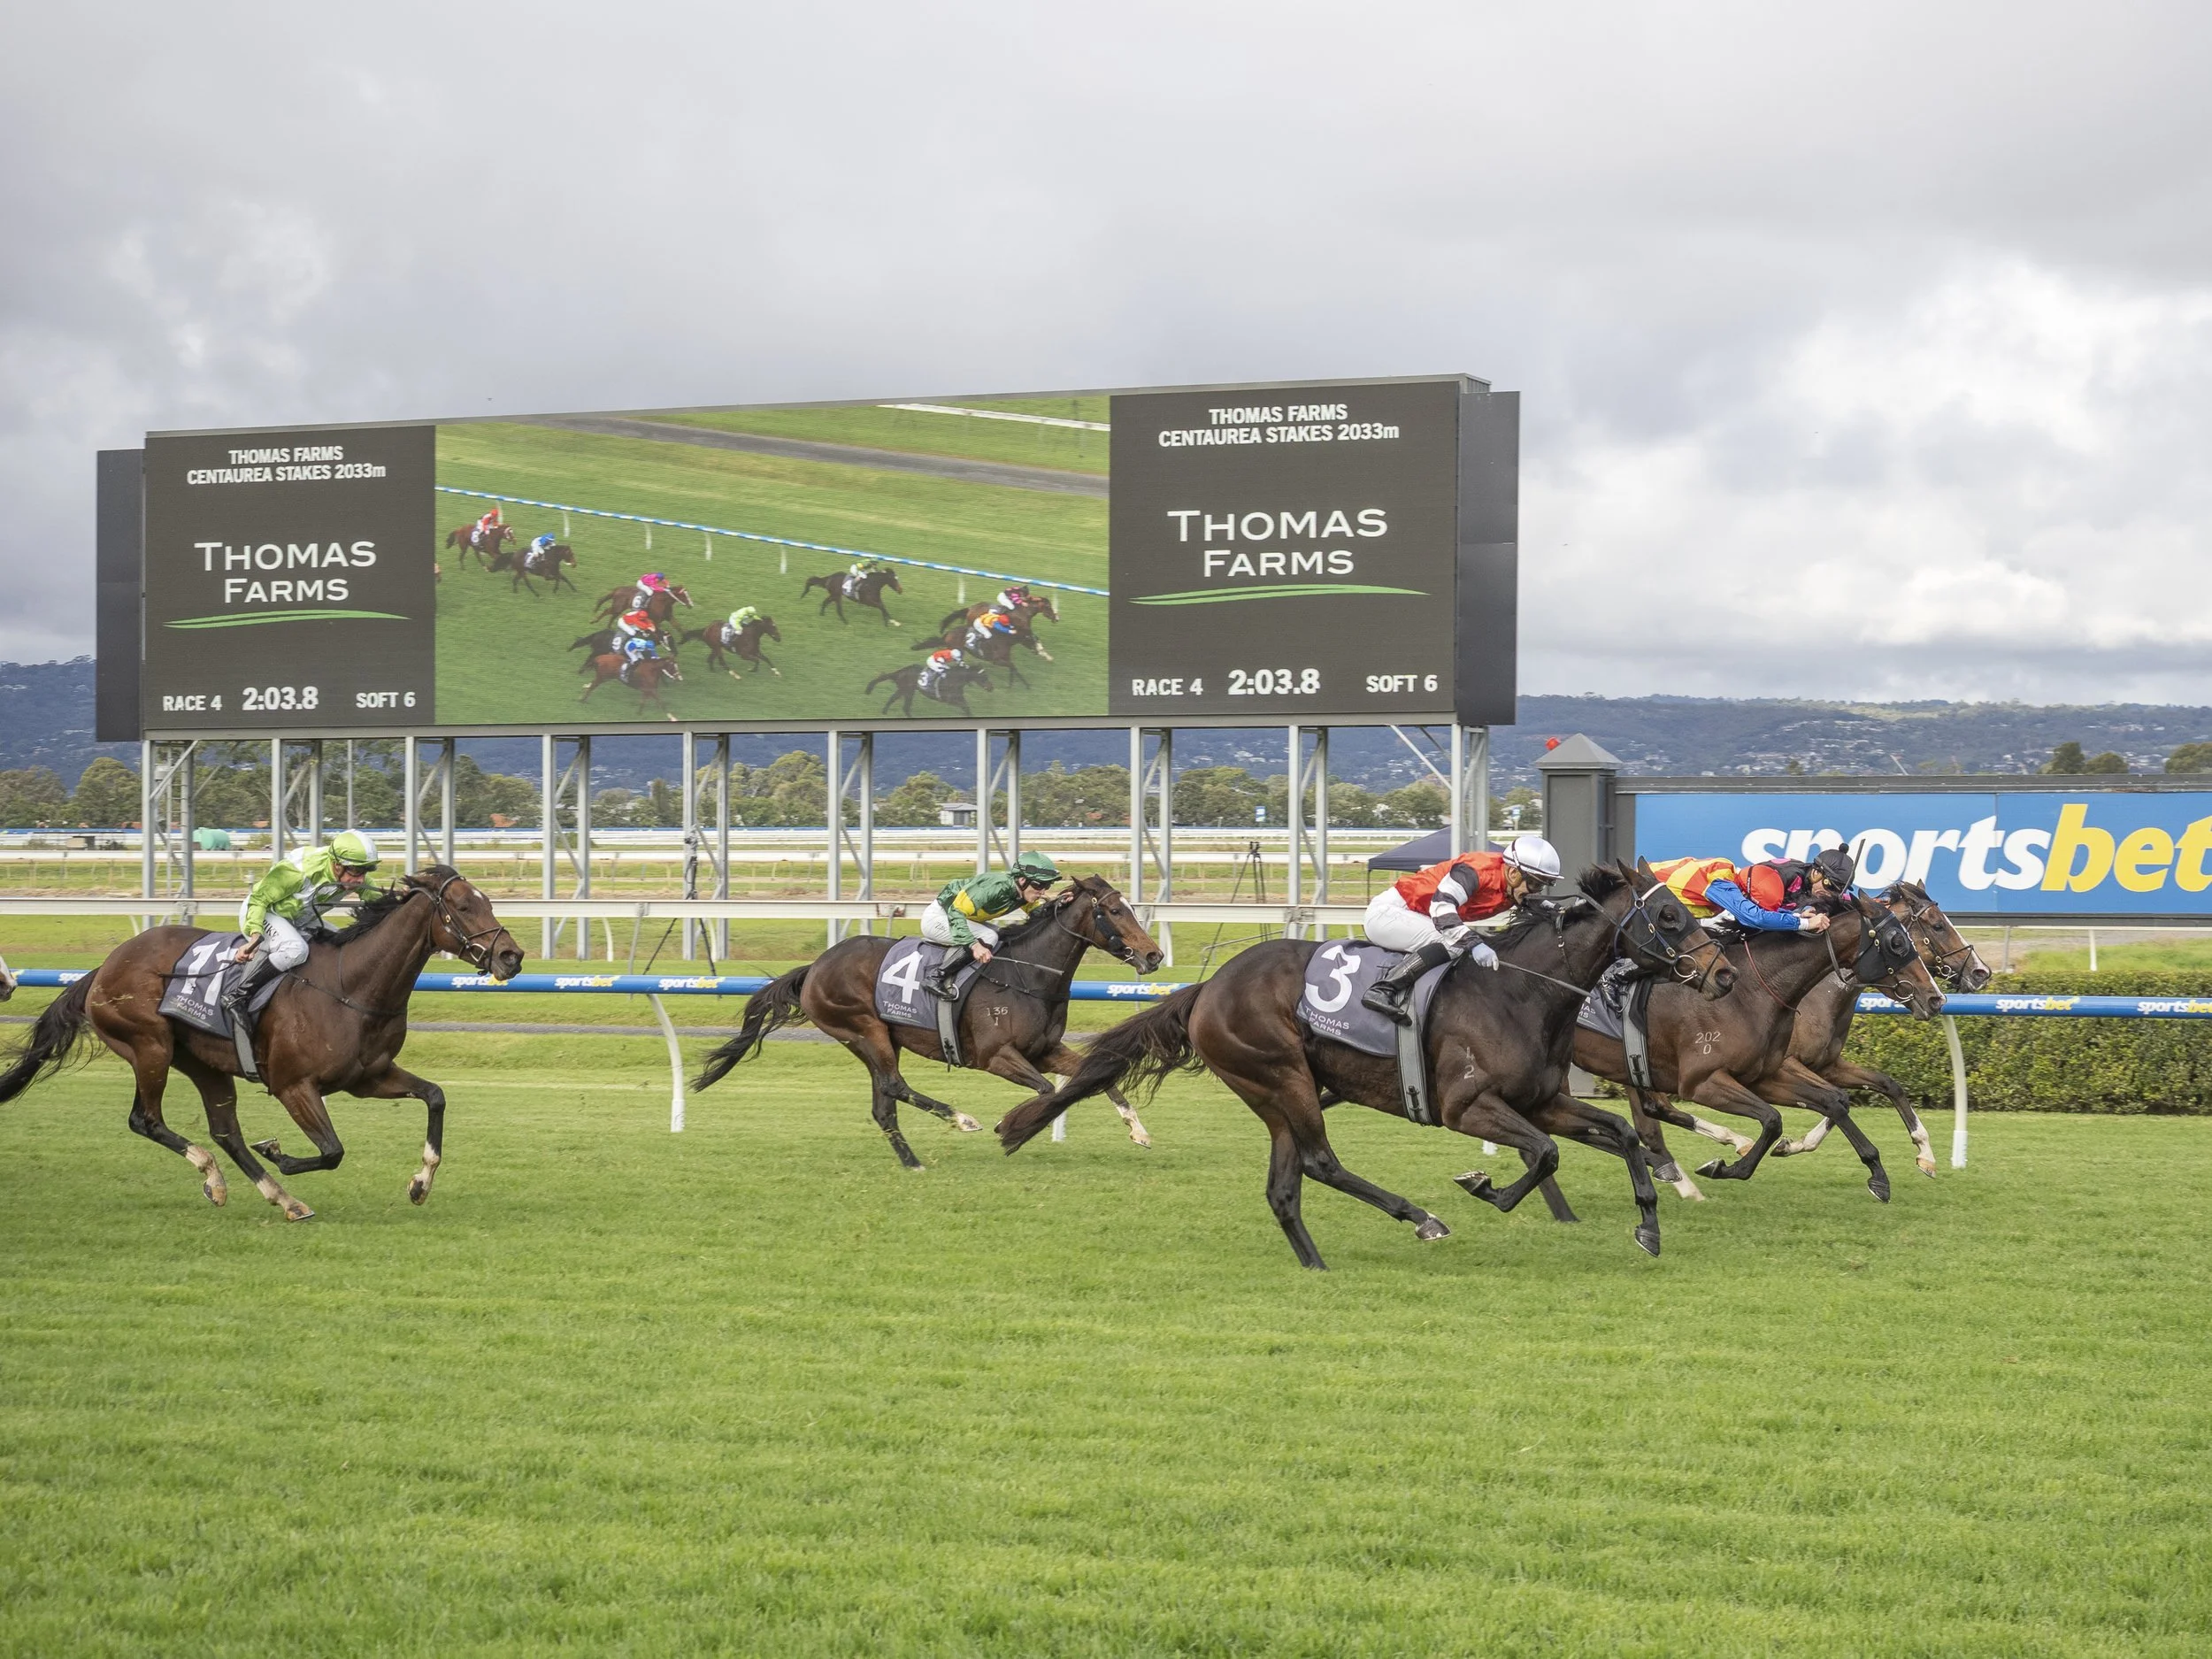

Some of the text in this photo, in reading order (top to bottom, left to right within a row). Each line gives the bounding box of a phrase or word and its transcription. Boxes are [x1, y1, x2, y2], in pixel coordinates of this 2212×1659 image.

[1209, 404, 1348, 425] THOMAS FARMS
[1158, 423, 1399, 447] CENTAUREA STAKES 2033m
[228, 446, 343, 465] THOMAS FARMS
[187, 463, 386, 485] CENTAUREA STAKES 2033m
[1167, 509, 1388, 542] THOMAS
[194, 541, 377, 571] THOMAS
[1204, 549, 1355, 578] FARMS
[225, 579, 349, 603] FARMS
[1132, 678, 1203, 696] RACE 4
[1228, 668, 1320, 695] 2:03.8
[1366, 674, 1438, 693] SOFT 6
[163, 695, 222, 710] RACE 4
[242, 686, 319, 710] 2:03.8
[356, 691, 416, 708] SOFT 6
[555, 975, 617, 988] sportsbet
[658, 976, 721, 990] sportsbet
[881, 951, 923, 1004] 4
[1304, 944, 1361, 1013] 3
[1107, 983, 1176, 997] sportsbet
[176, 995, 214, 1016] THOMAS
[883, 1000, 918, 1014] THOMAS
[887, 1008, 912, 1018] FARMS
[1996, 996, 2076, 1012] sportsbet
[1304, 1005, 1349, 1030] THOMAS
[1309, 1018, 1341, 1036] FARMS
[1694, 1031, 1721, 1044] 202
[1463, 1064, 1475, 1079] 2
